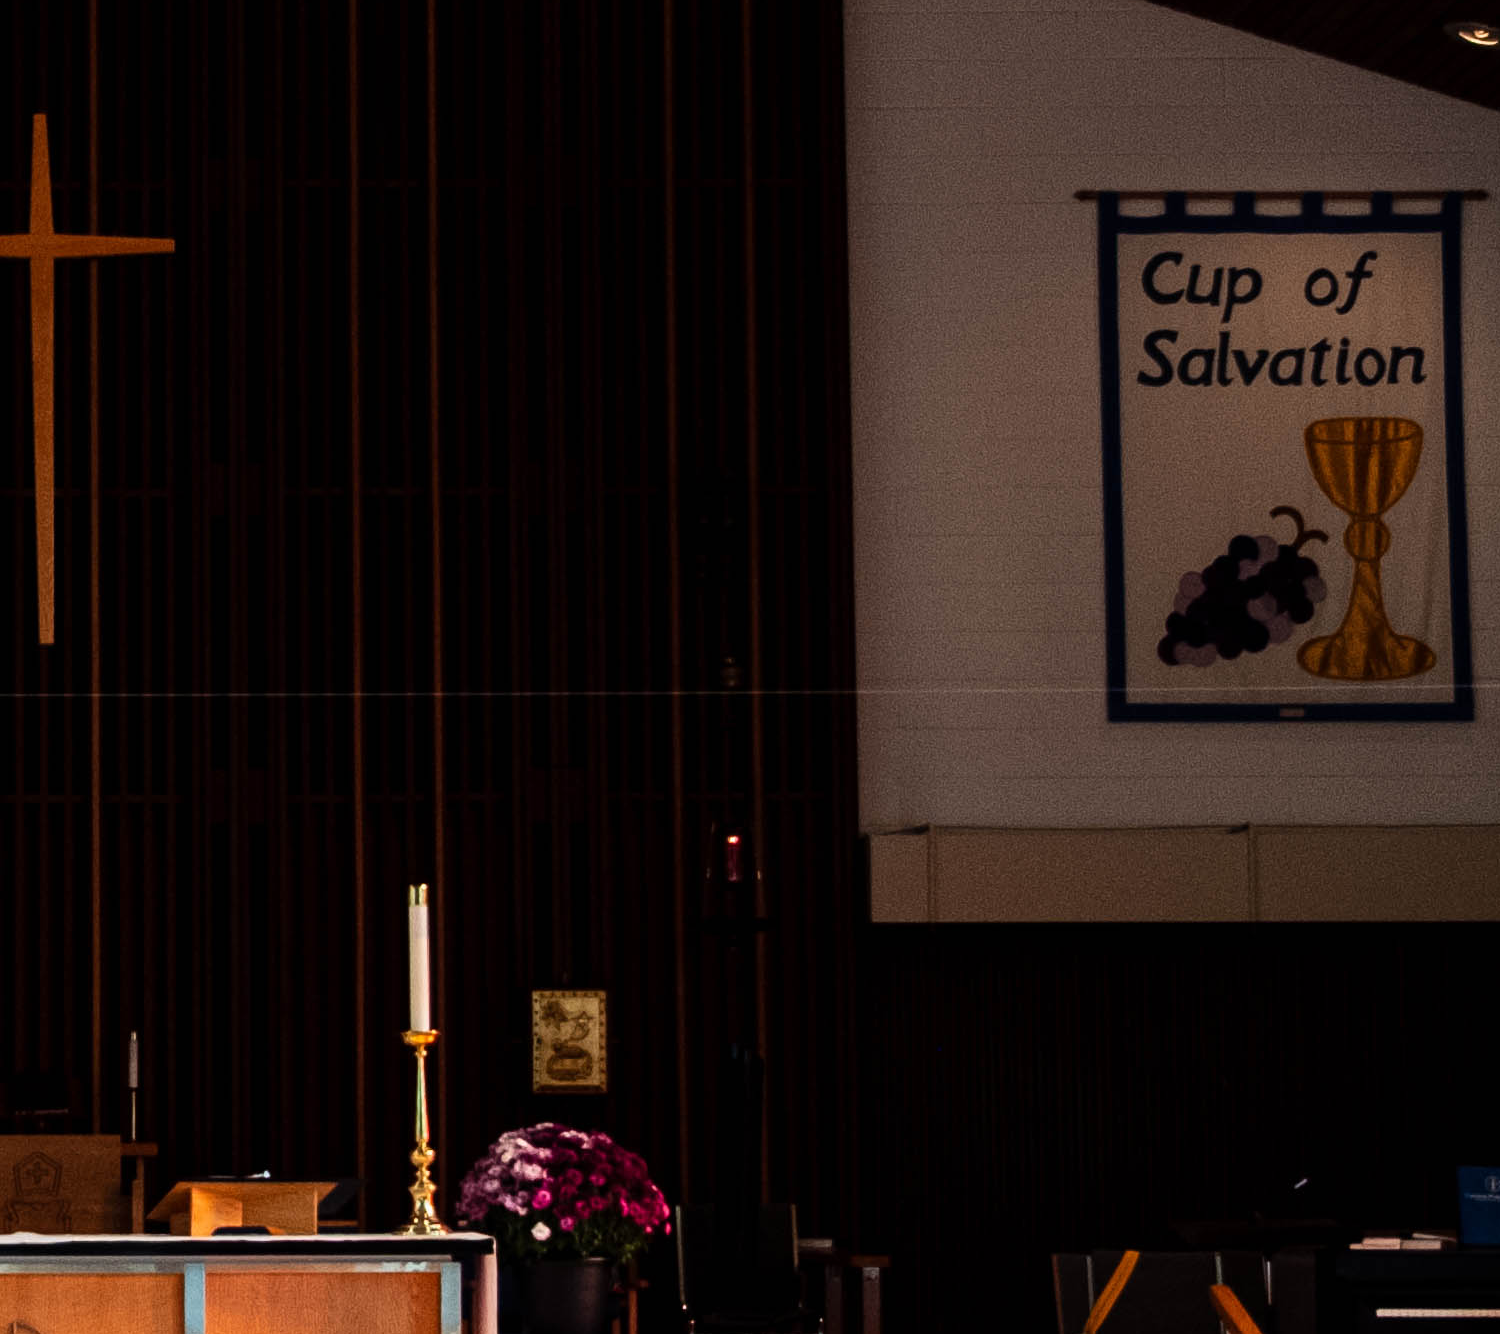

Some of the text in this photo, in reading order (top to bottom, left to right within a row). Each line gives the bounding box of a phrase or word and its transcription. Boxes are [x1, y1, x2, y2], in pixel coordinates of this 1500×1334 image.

[1141, 250, 1378, 323] Cup of
[1137, 329, 1426, 387] Salvation
